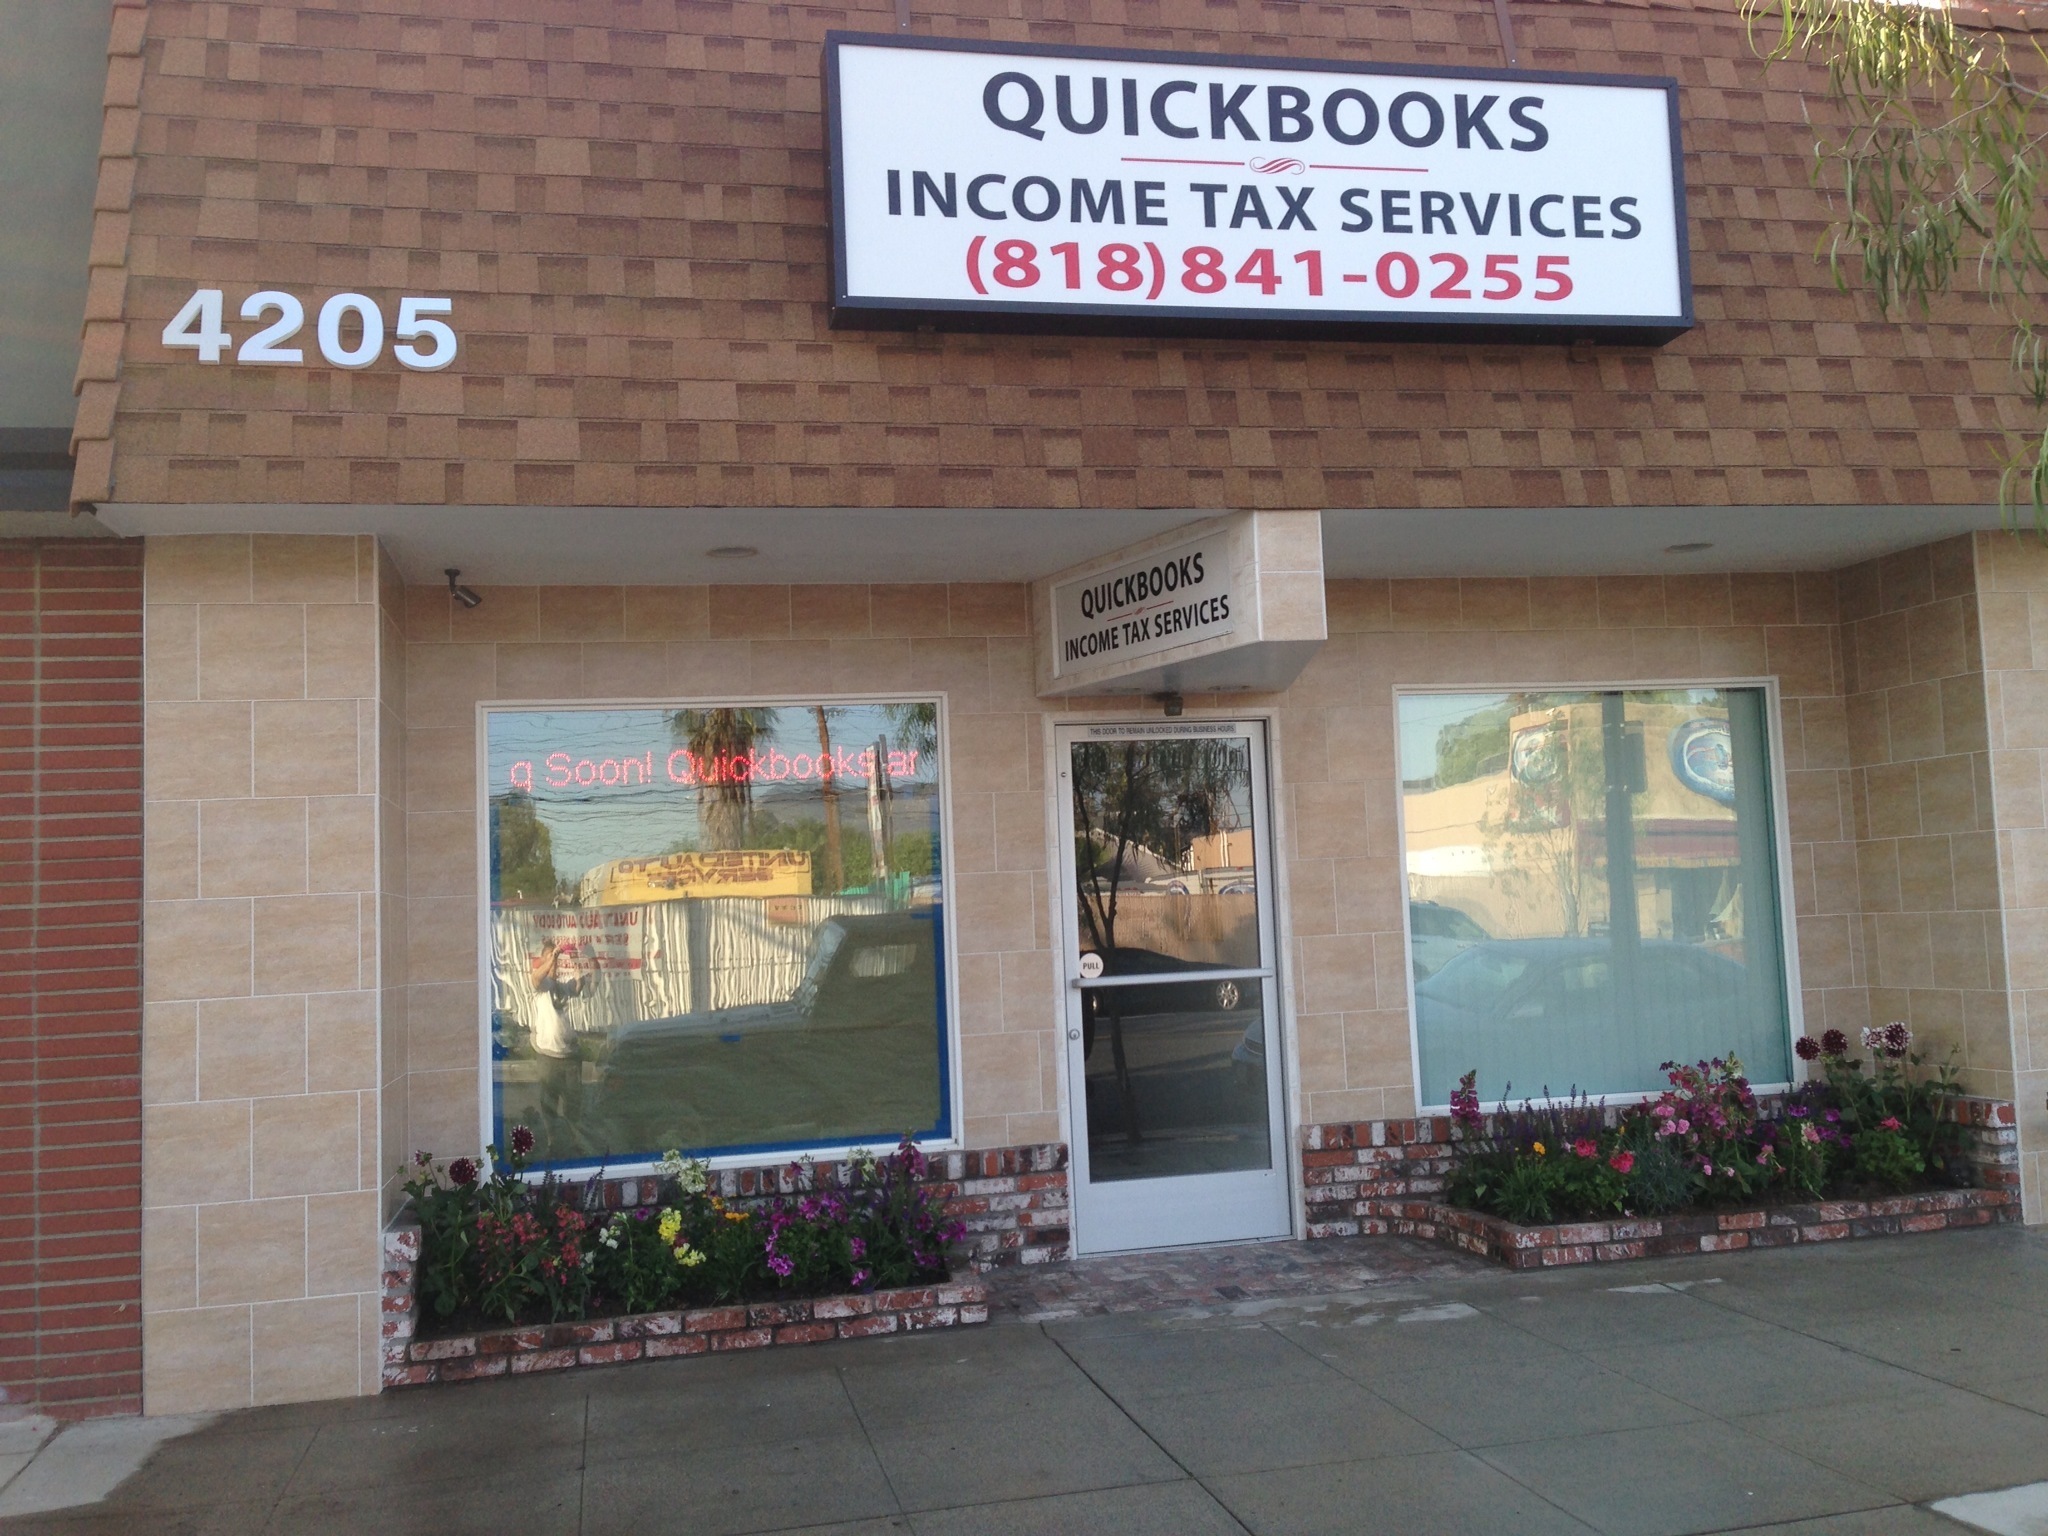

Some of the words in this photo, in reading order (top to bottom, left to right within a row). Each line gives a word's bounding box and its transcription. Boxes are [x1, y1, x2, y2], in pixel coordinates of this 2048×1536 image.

[982, 70, 1550, 152] QUICKBOOKS
[886, 168, 1169, 228] INCOME
[1190, 181, 1317, 232] TAX
[1340, 187, 1643, 240] SERVICES
[965, 235, 1575, 302] (818)841-0255
[161, 289, 458, 372] 4205
[1081, 552, 1205, 619] QUICKBOOKS
[1065, 626, 1120, 662] INCOME
[1123, 617, 1151, 646] TAX
[1154, 594, 1229, 638] SERVICES
[1102, 727, 1117, 735] DOOR
[1146, 726, 1172, 734] UNLOCKED
[1192, 725, 1216, 733] BUSINESS
[545, 751, 653, 787] Soon!
[667, 746, 876, 785] Quickbooks
[1082, 962, 1100, 970] PULL
